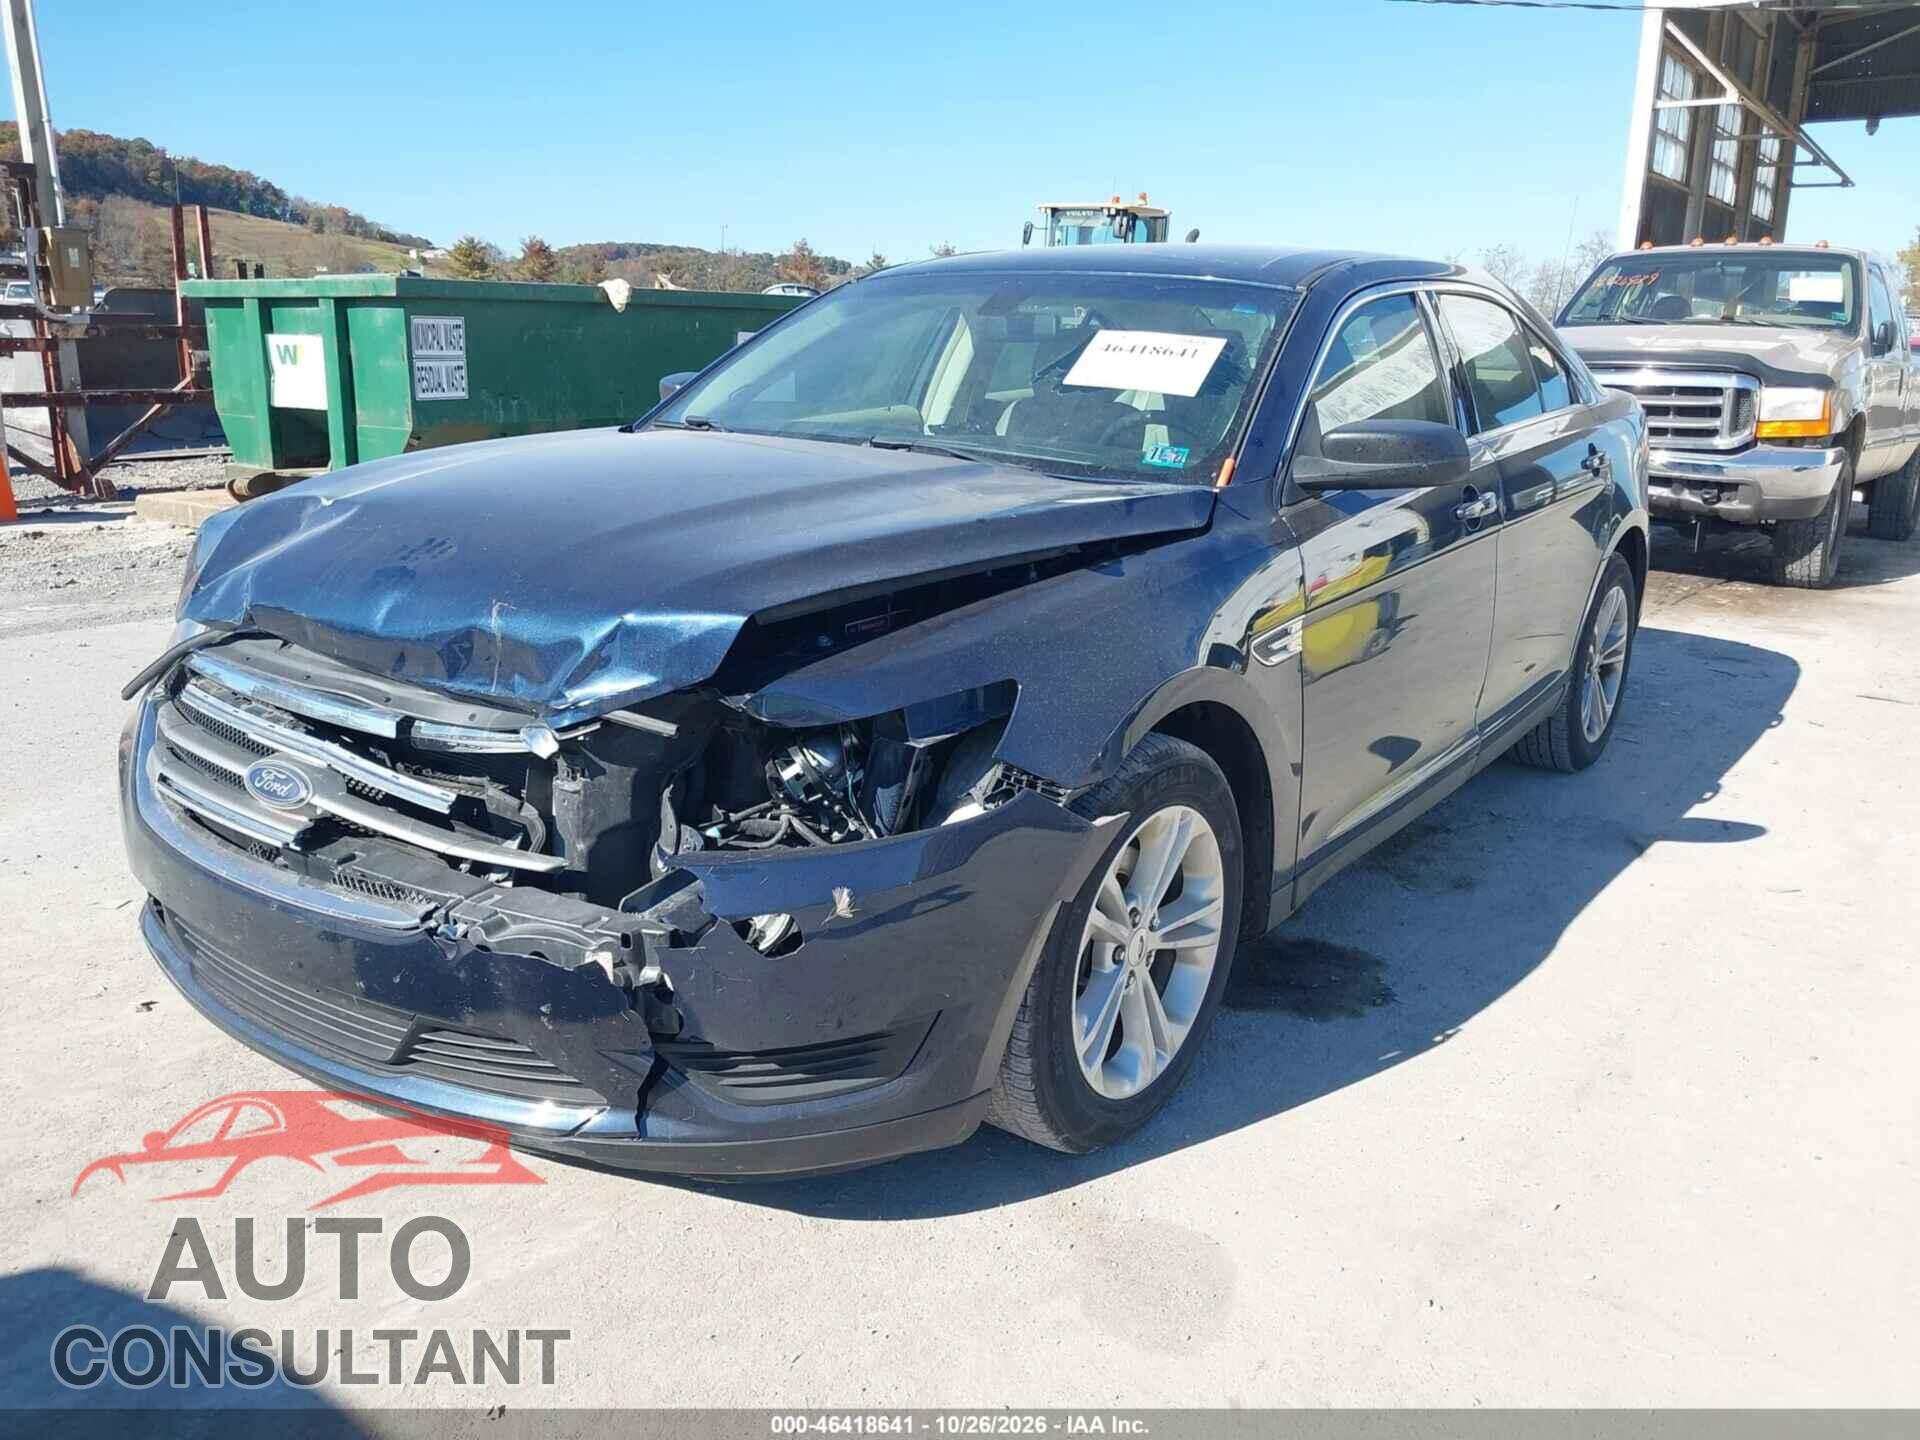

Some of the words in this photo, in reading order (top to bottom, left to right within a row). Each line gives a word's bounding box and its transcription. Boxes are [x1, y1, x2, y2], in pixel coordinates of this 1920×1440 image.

[444, 323, 462, 351] WASTE
[446, 365, 465, 393] WASTE
[254, 769, 295, 797] Ford
